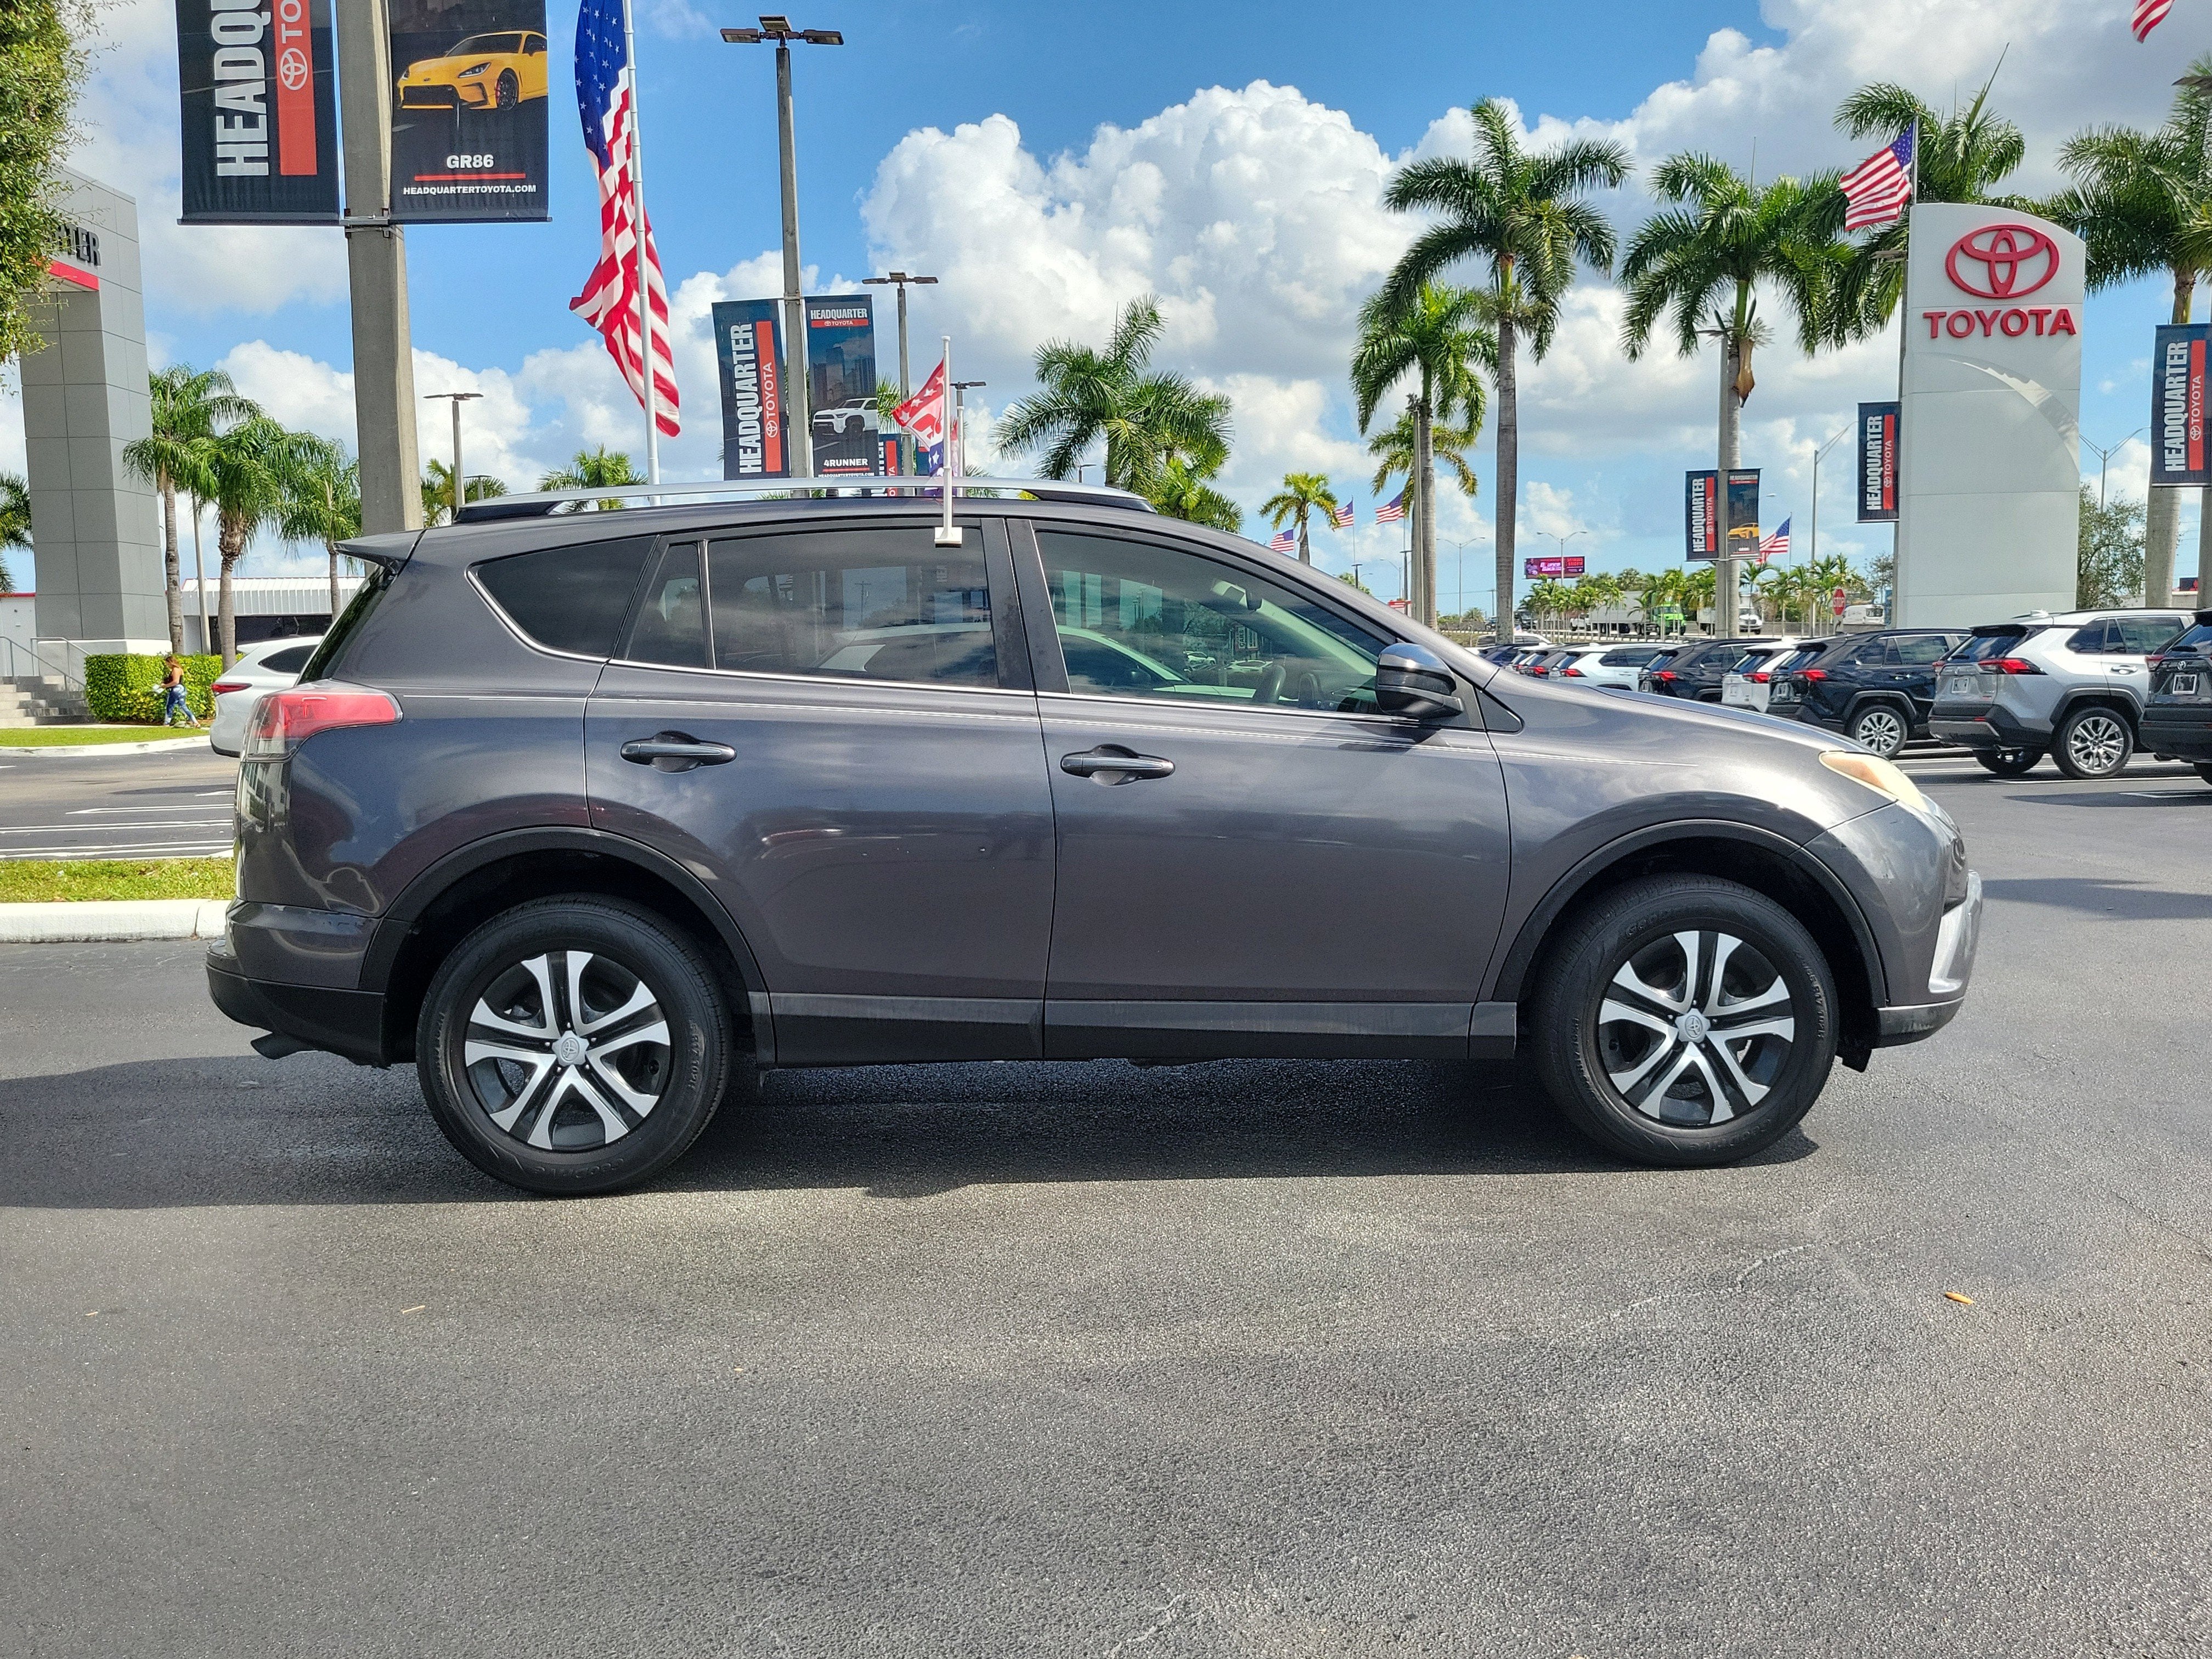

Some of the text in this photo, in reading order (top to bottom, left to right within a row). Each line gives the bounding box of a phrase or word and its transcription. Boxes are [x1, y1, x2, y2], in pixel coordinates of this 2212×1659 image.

[446, 154, 494, 169] GR86
[403, 185, 536, 195] HEADQUARTERTOYOTA.COM
[810, 308, 867, 320] HEADQUARTER
[1922, 308, 2076, 338] TOYOTA
[730, 323, 763, 473] HEADQUARTER
[763, 362, 776, 419] TOYOTA
[2164, 341, 2188, 472] HEADQUARTER
[2191, 375, 2201, 425] TOYOTA
[823, 458, 868, 467] 4RUNNER
[1866, 415, 1883, 510] HEADQUARTER
[1884, 440, 1892, 475] TOYOTA
[1692, 478, 1706, 552] HEADQUARTER
